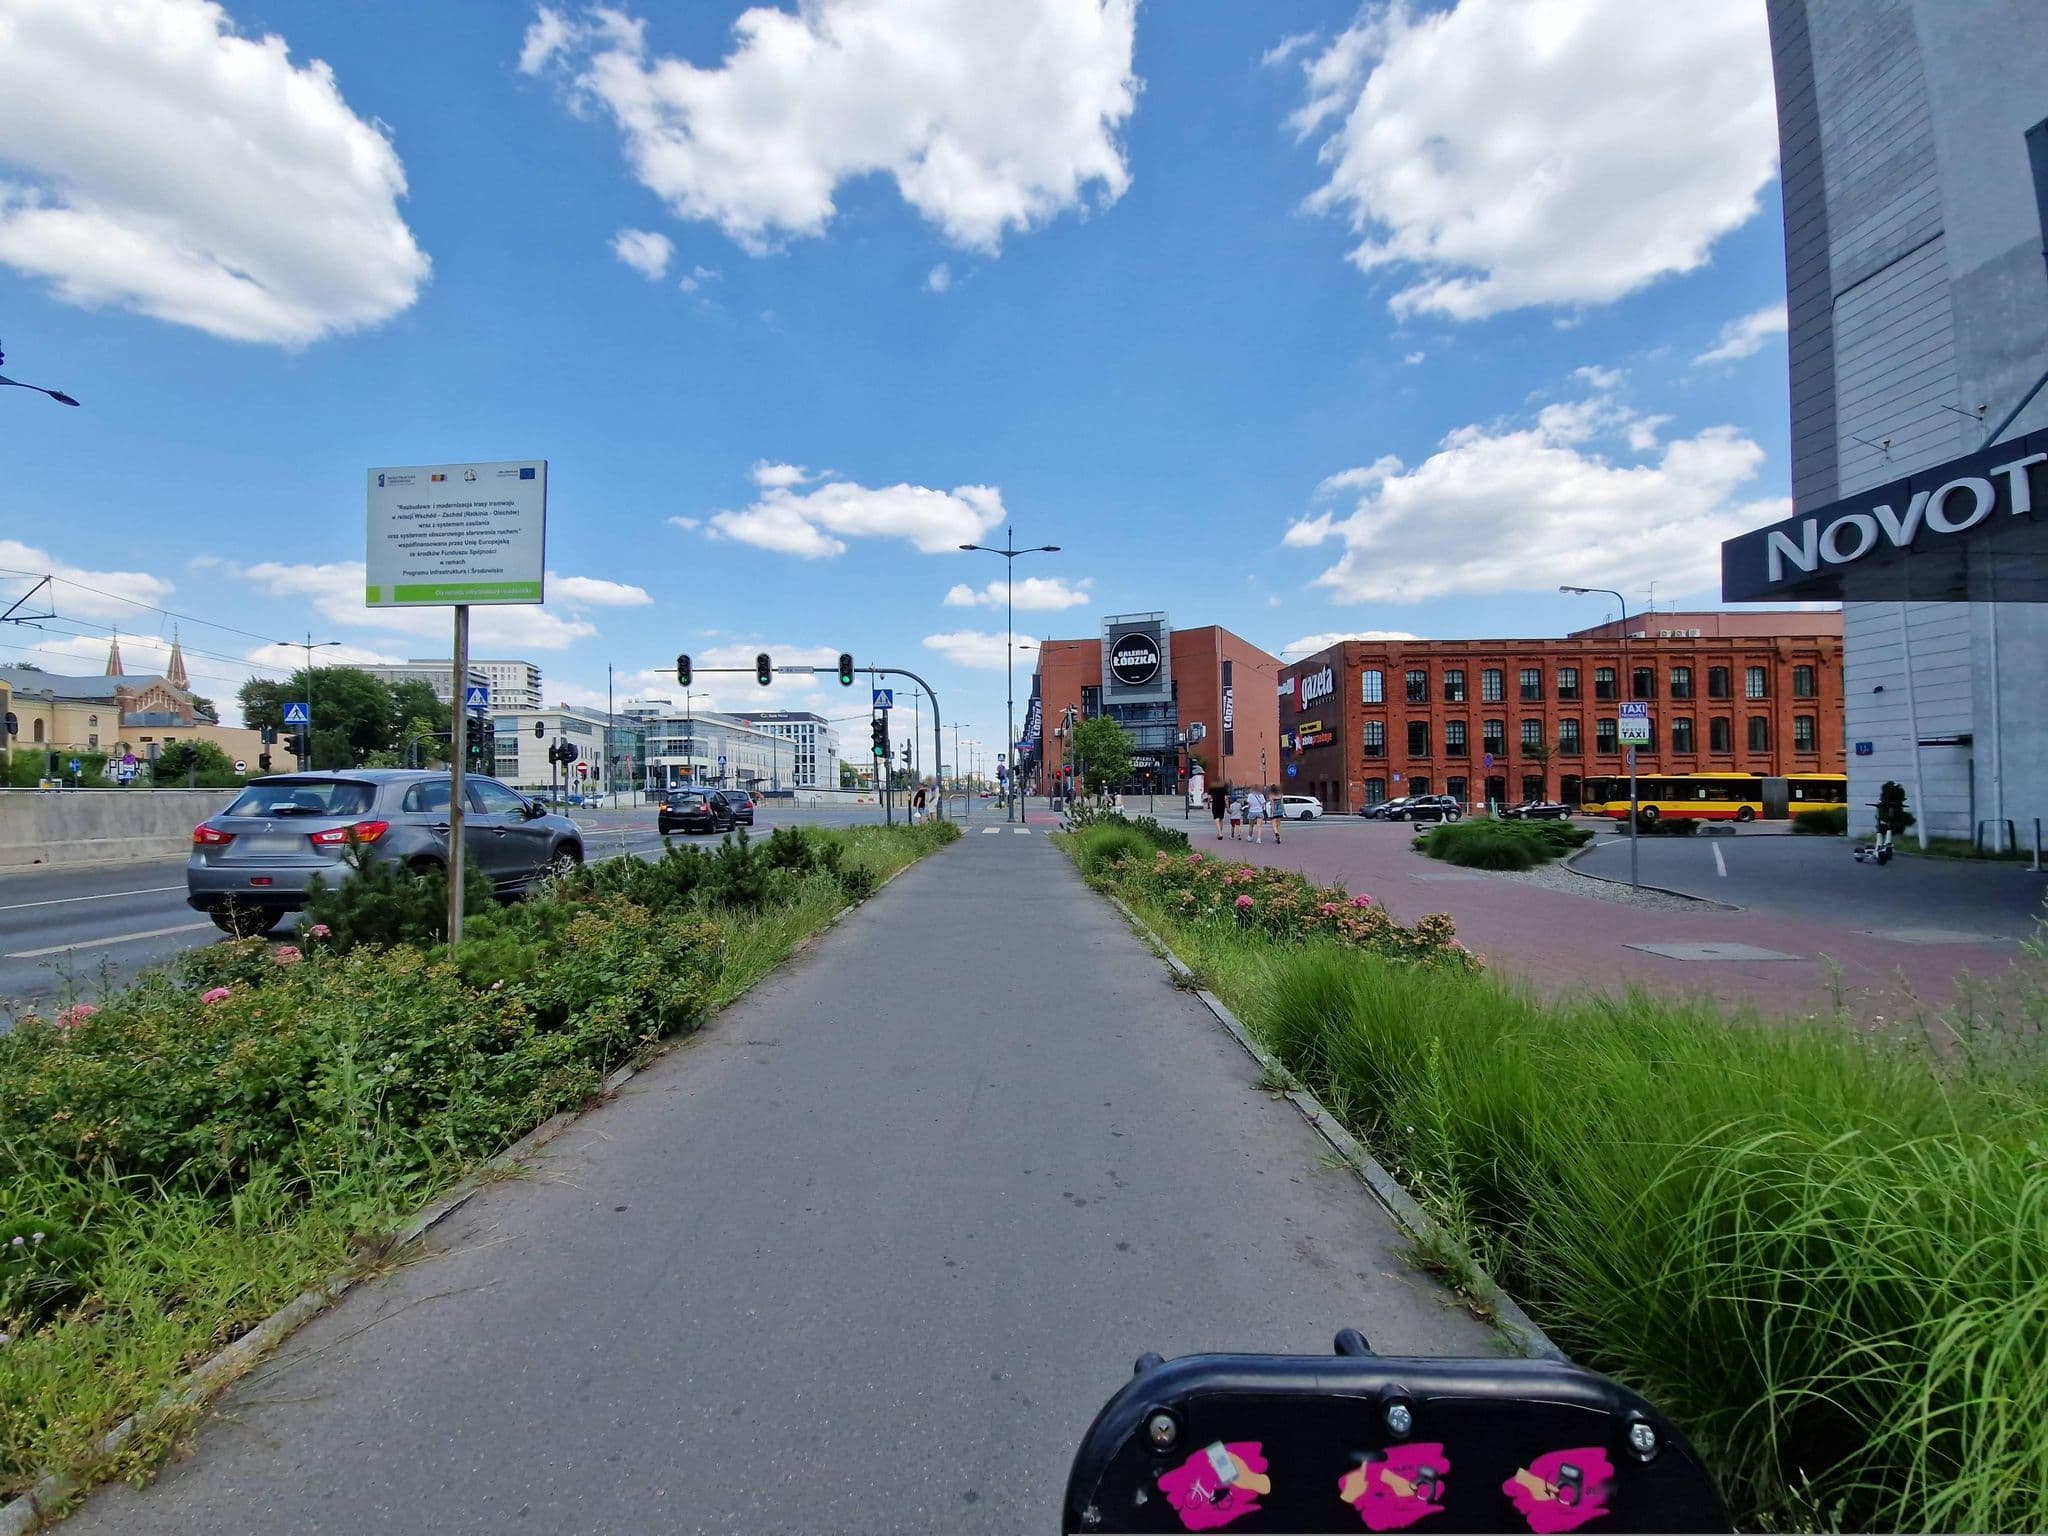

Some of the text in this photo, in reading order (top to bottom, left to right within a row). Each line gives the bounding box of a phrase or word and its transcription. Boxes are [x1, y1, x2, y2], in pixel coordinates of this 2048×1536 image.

[1767, 452, 2048, 582] NOVOT
[1118, 649, 1149, 658] GALERIA
[1301, 665, 1334, 711] gazeta
[1622, 704, 1645, 713] TAXI
